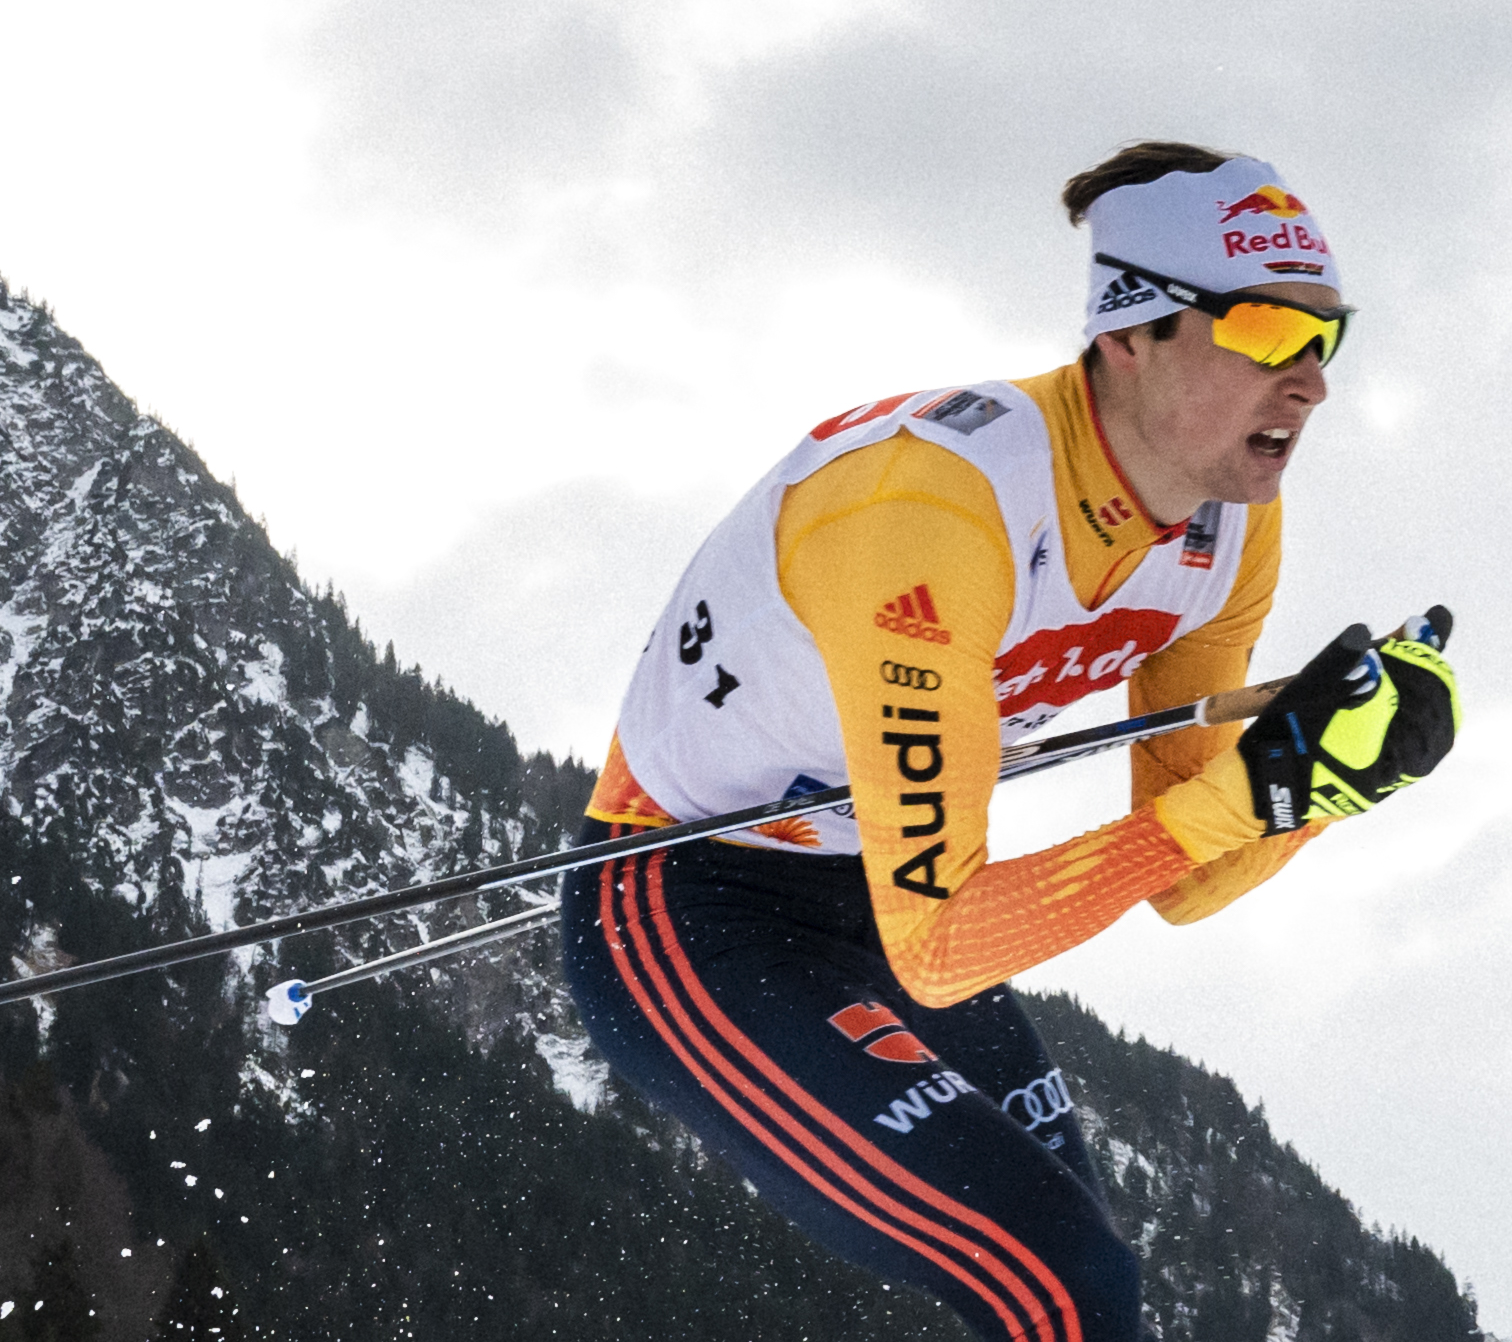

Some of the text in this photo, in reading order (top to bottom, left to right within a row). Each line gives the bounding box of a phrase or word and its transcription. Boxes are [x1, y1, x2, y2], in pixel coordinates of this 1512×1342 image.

[1223, 222, 1330, 259] Red Bu
[1096, 288, 1156, 315] adidas
[874, 611, 952, 646] adidas
[882, 704, 950, 901] Audi
[873, 1070, 979, 1134] WÜR
